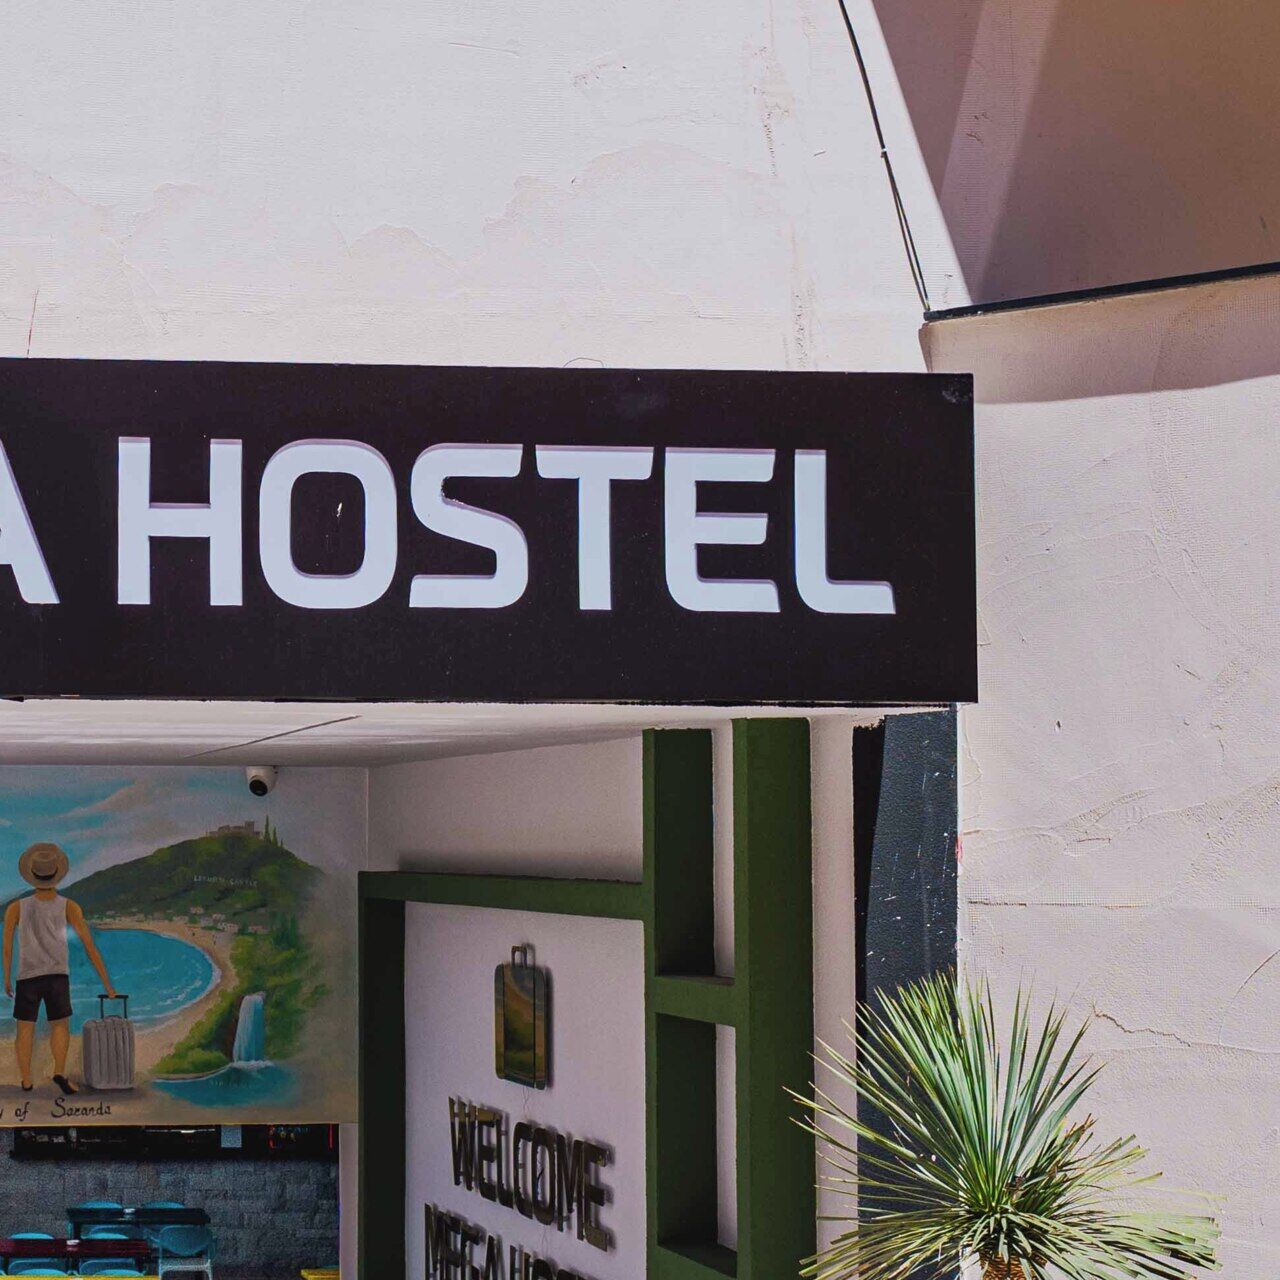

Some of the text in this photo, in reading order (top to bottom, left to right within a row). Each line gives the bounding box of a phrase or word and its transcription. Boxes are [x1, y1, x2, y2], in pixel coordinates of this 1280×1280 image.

[117, 435, 897, 615] HOSTEL
[15, 1101, 30, 1122] of
[448, 1096, 609, 1252] WELCOME
